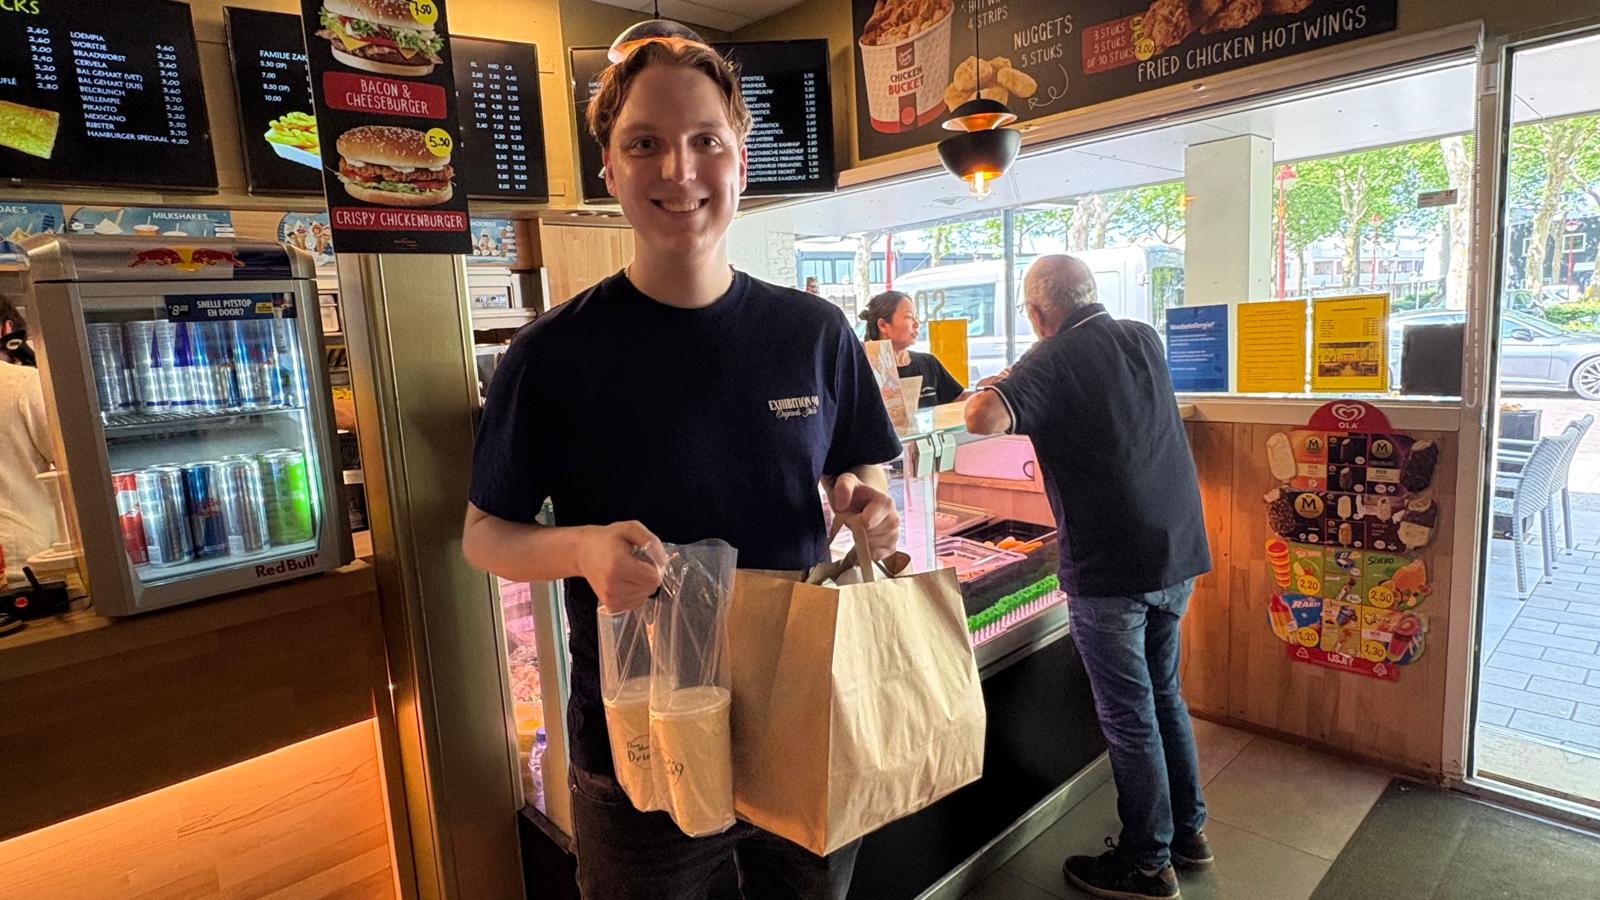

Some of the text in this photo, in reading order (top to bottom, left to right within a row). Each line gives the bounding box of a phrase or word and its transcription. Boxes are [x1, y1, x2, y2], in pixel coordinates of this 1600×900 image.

[968, 5, 1008, 31] 4 STRIPS
[70, 31, 105, 41] LOEMPIA
[1014, 14, 1073, 50] NUGGETS
[1101, 22, 1126, 40] STUKS
[71, 40, 107, 51] WORSTJE
[1101, 35, 1126, 52] STUKS
[1138, 5, 1367, 82] FRIED CHICKEN HOT WINGS
[73, 49, 127, 62] BRAADWORST
[260, 50, 291, 60] FAMILIE
[1021, 43, 1063, 68] 5 STUKS
[1099, 54, 1108, 65] 10
[1109, 47, 1135, 63] STUKS
[75, 59, 108, 69] CERVELA
[76, 67, 91, 75] BAL
[92, 70, 123, 79] GEHAKT
[890, 65, 923, 83] CHICKEN
[78, 77, 93, 85] BAL
[94, 79, 123, 88] GEHAKT
[888, 74, 924, 96] BUCKET
[79, 86, 126, 97] BELCRUNCH
[360, 79, 412, 100] BACON &
[82, 104, 118, 113] PIKANTO
[346, 92, 429, 115] CHEESEBURGER
[84, 113, 127, 122] MEXICANO
[86, 122, 116, 130] RIBSTER
[87, 131, 136, 141] HAMBURGER
[137, 134, 169, 143] SPECIAAL
[152, 211, 209, 221] MILKSHAKES
[336, 210, 464, 229] CRISPY CHICKENBURGER
[197, 298, 252, 309] SNELLE PITSTOP
[207, 308, 245, 317] EN DOOR?
[1338, 421, 1358, 429] OLA
